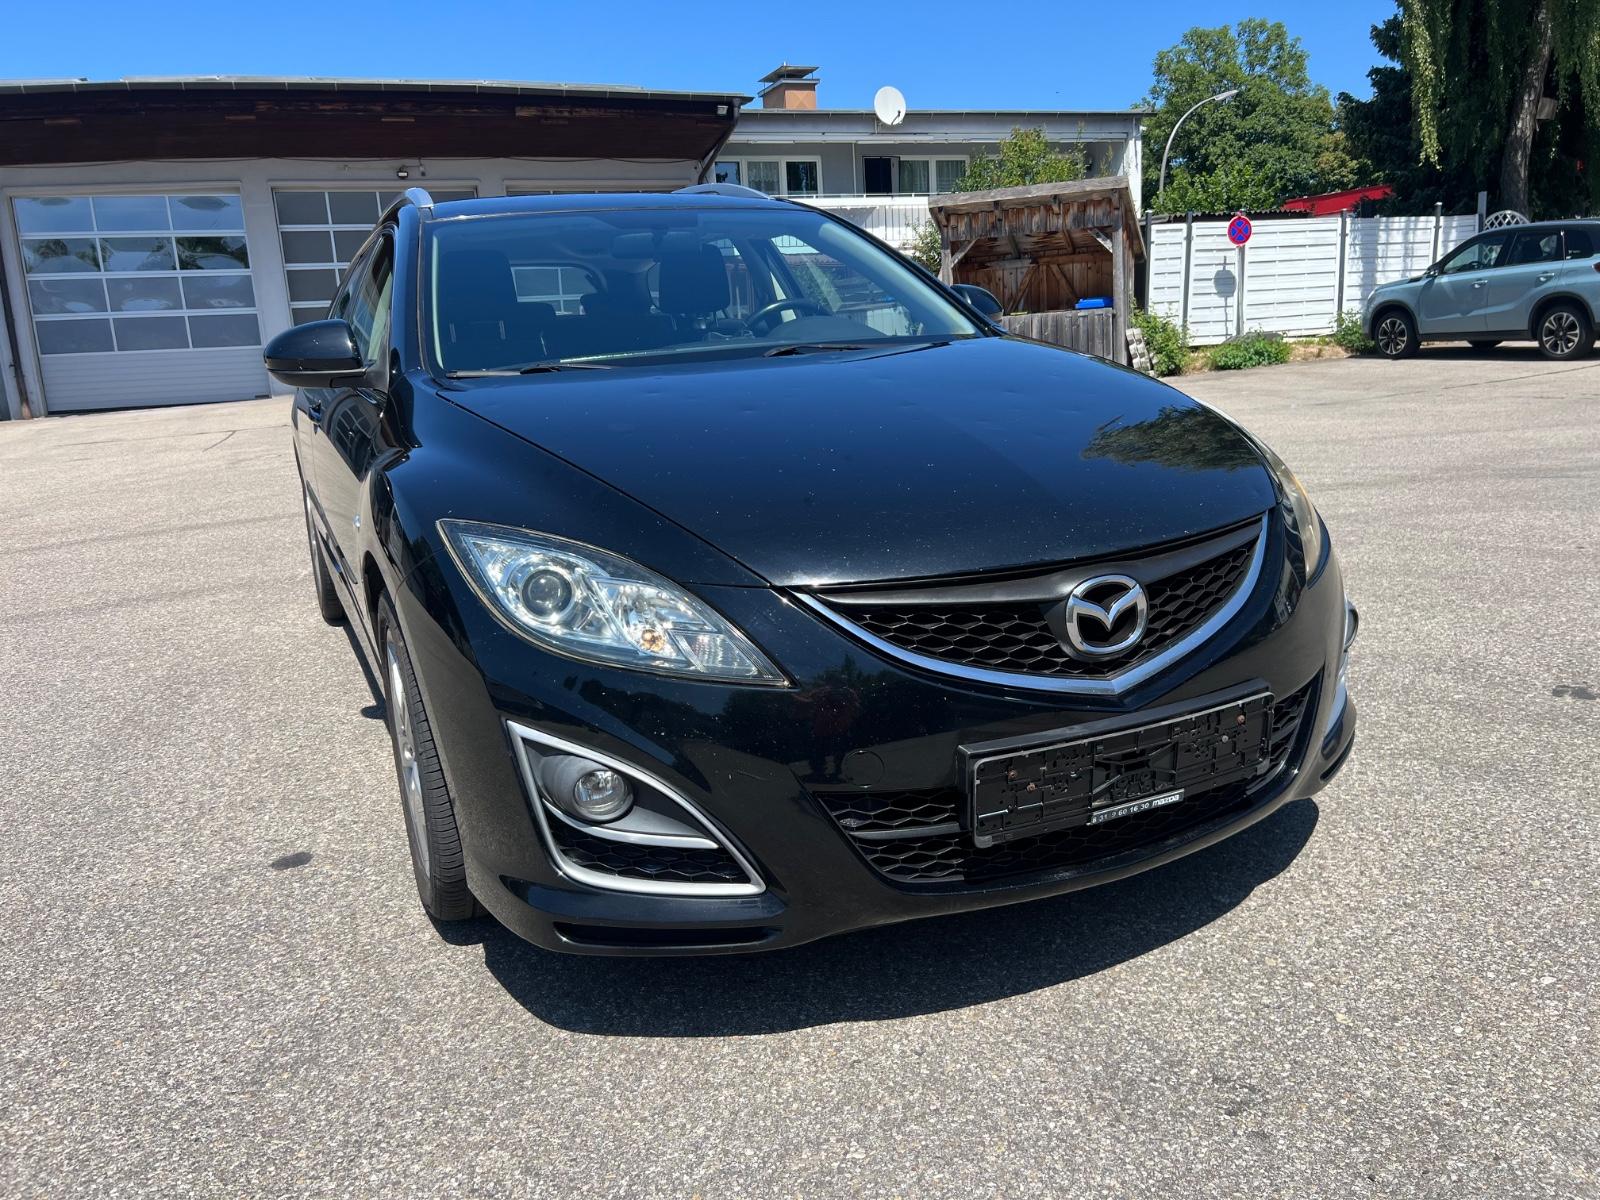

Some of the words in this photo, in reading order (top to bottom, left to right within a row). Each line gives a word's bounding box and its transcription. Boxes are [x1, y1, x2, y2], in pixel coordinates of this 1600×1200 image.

[1118, 808, 1128, 816] 60
[1130, 805, 1139, 813] 16
[1140, 802, 1150, 810] 30
